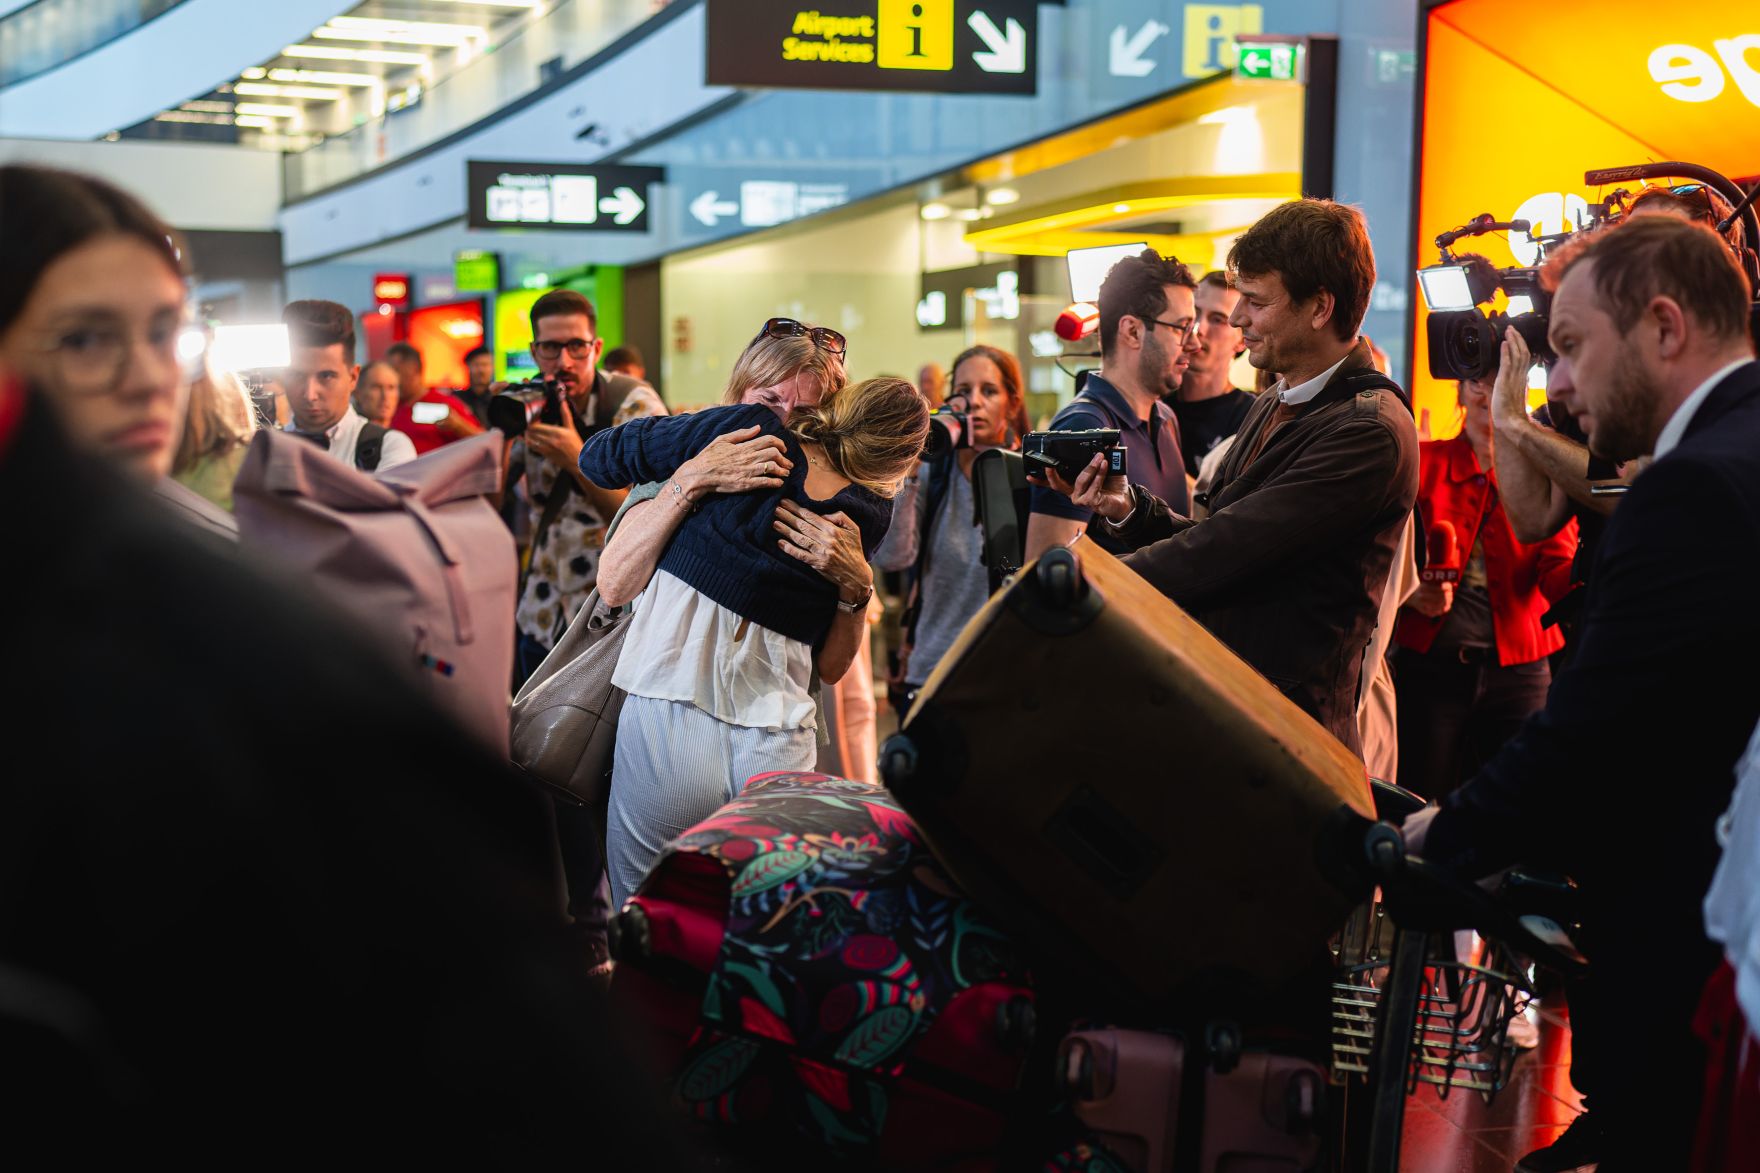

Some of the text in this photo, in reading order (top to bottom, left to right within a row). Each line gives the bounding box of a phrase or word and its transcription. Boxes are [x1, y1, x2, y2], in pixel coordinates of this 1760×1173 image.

[792, 11, 875, 39] Airport
[782, 37, 875, 63] Services
[1422, 570, 1457, 580] ORF
